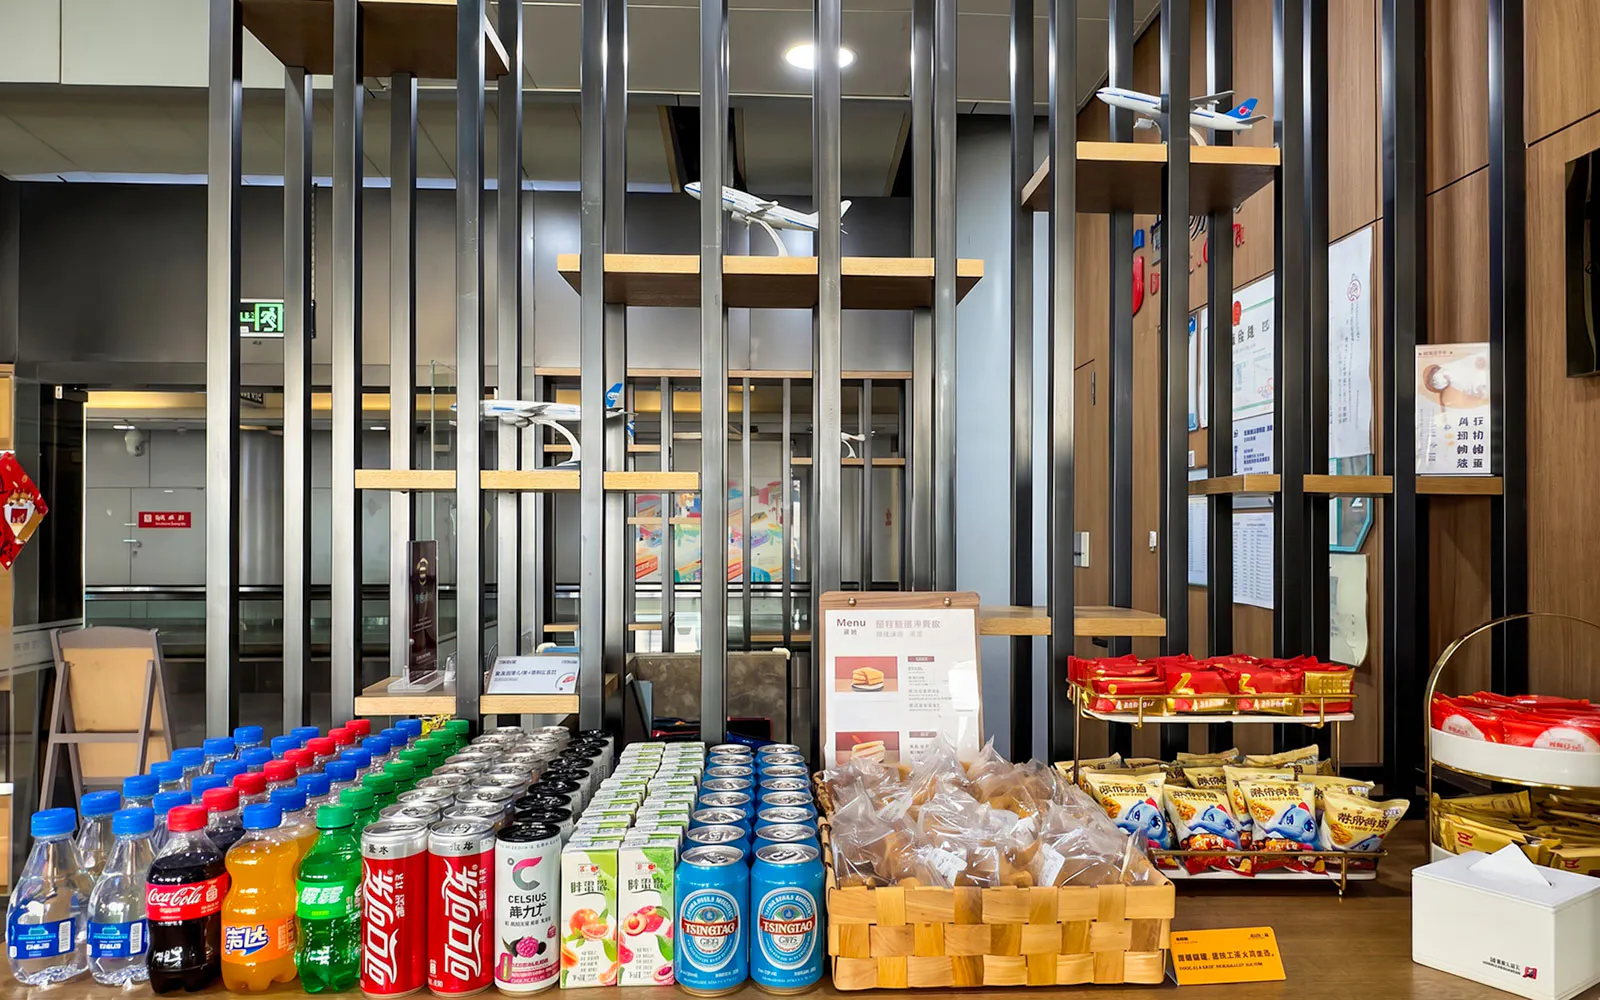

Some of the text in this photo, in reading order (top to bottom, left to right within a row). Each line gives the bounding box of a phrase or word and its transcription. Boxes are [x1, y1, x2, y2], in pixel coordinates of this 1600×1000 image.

[836, 618, 866, 627] Menu
[147, 885, 206, 907] Coca-Cola
[508, 892, 547, 904] CELSIUS
[441, 859, 482, 981] 可口可乐
[684, 922, 735, 936] TSINGTAO
[762, 921, 813, 936] TSINGTAO
